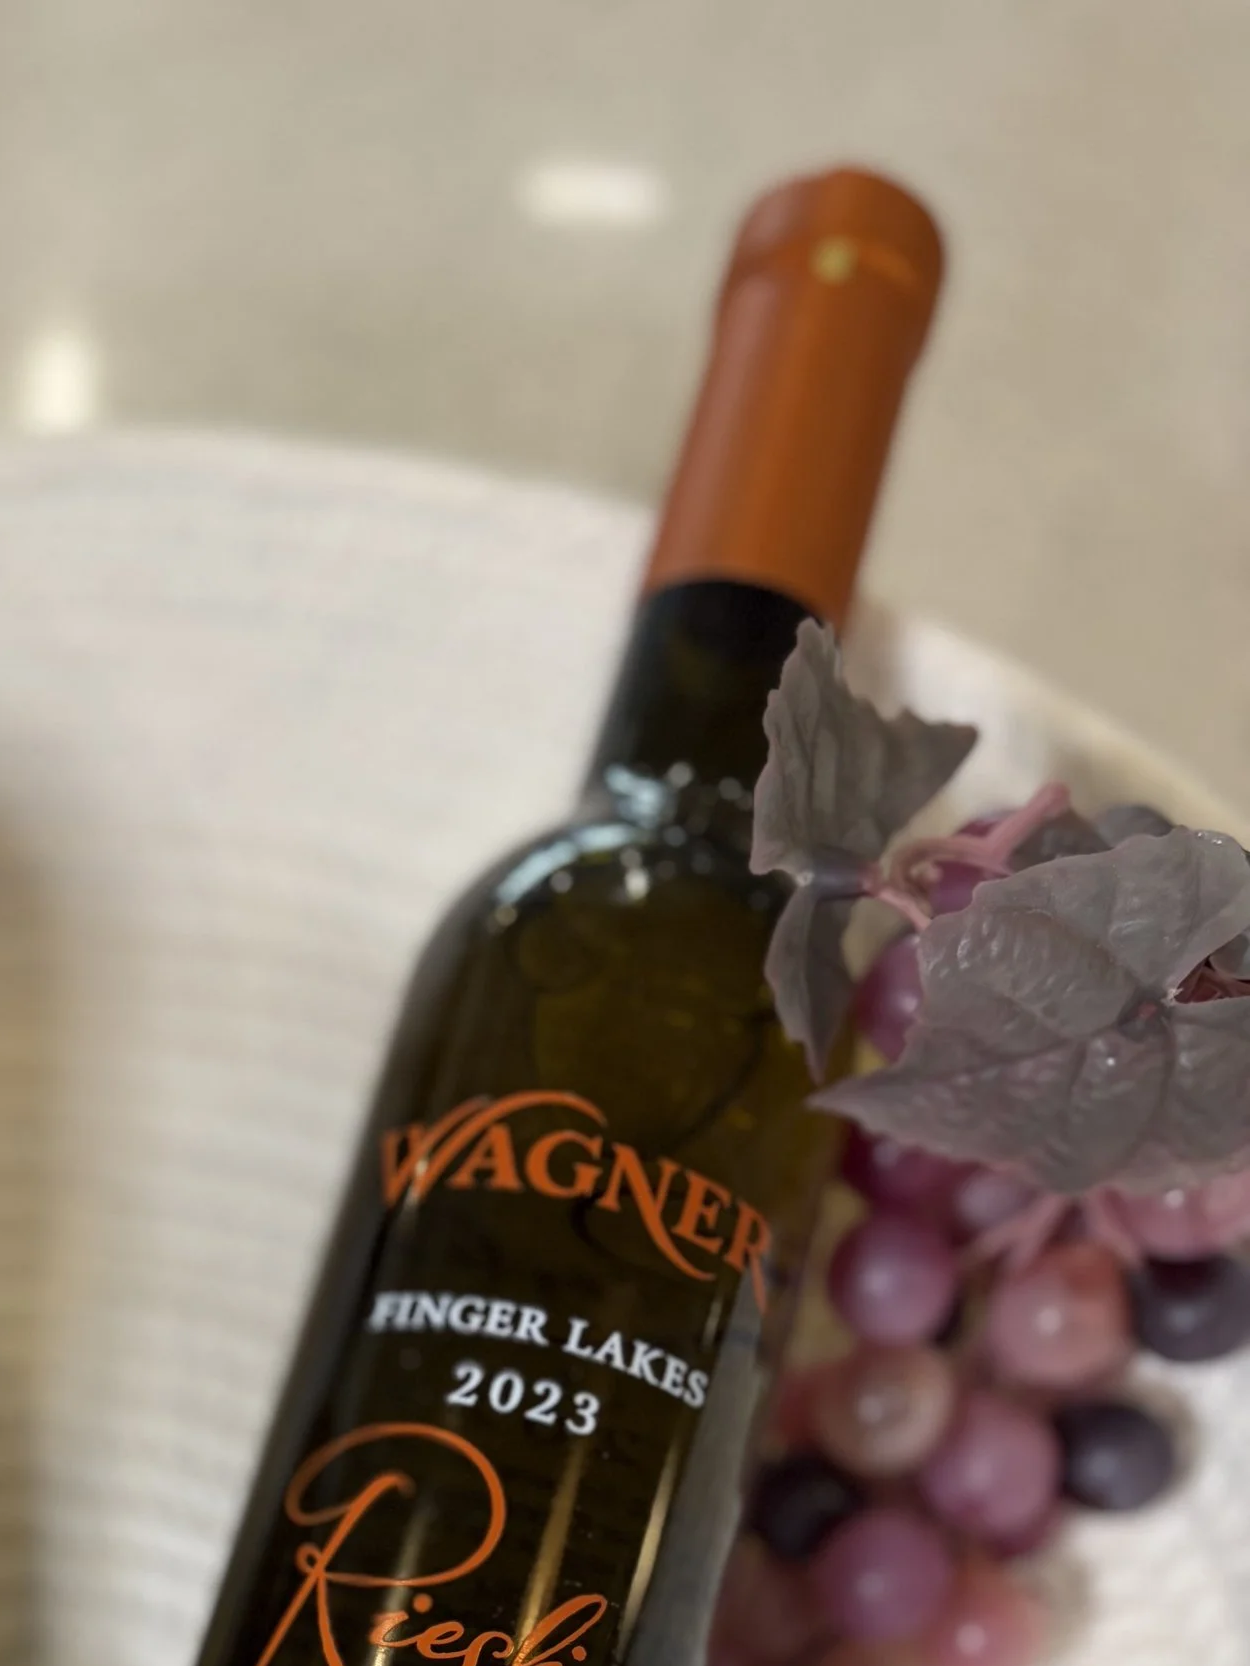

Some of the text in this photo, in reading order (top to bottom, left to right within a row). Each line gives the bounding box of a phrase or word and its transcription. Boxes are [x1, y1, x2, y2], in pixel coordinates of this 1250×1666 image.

[380, 1089, 772, 1316] WAGNER
[369, 1291, 710, 1408] FINGER LAKES
[446, 1361, 600, 1435] 2023
